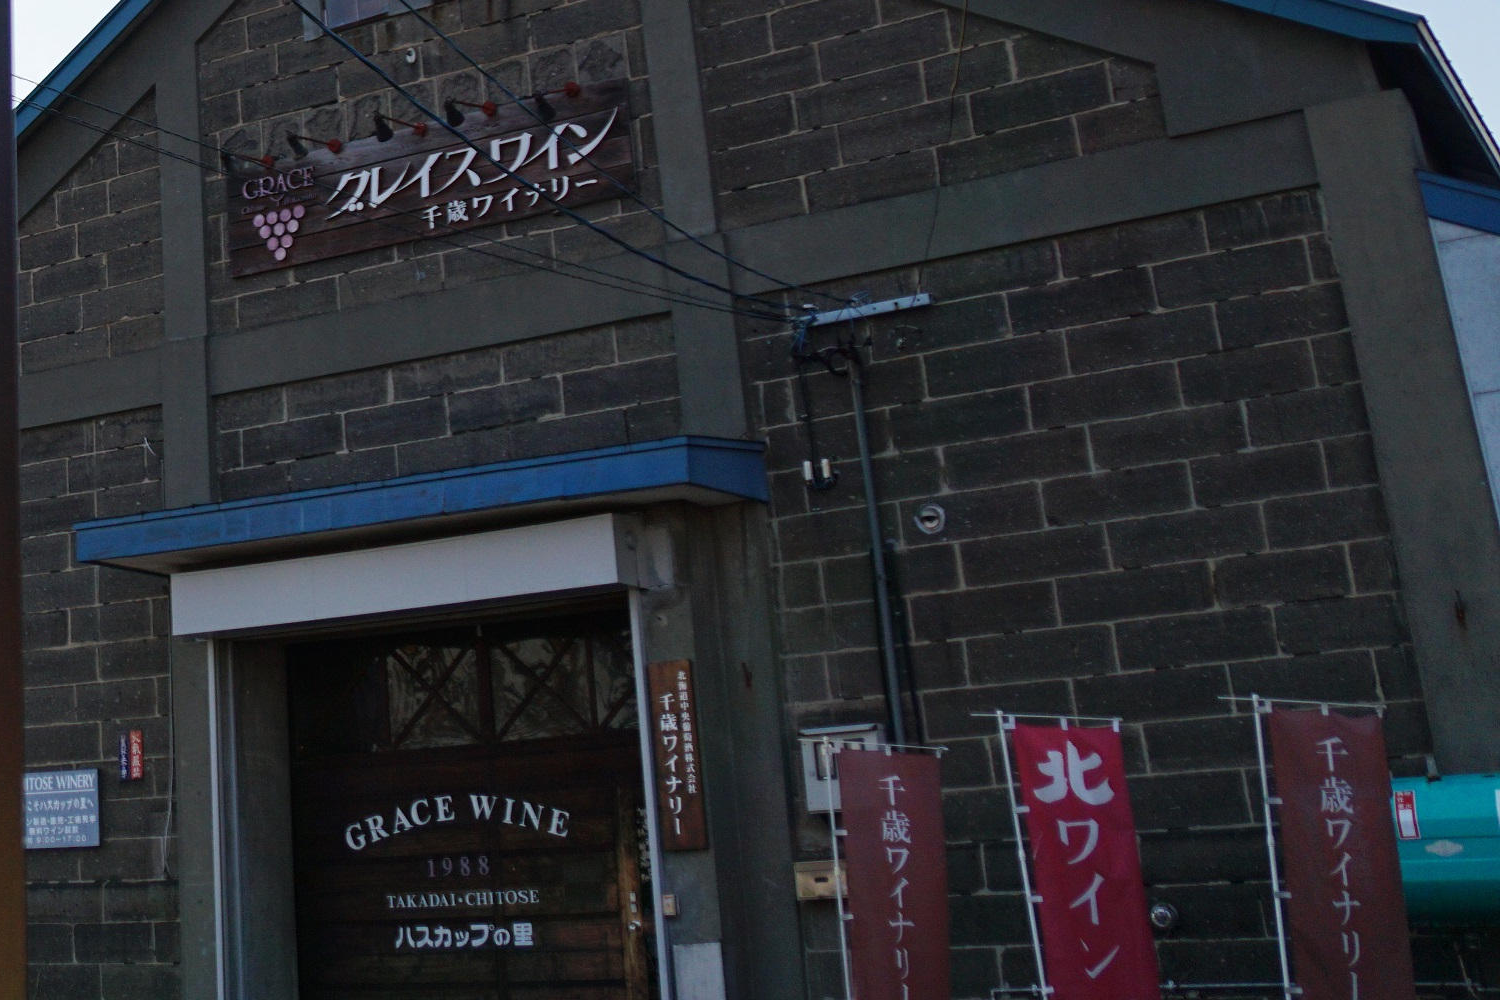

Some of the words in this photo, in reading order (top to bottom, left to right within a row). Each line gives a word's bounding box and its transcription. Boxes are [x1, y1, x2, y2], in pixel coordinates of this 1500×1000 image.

[242, 165, 316, 201] GRACE
[324, 105, 619, 221] グレイスワイン
[421, 176, 599, 230] 千歳ワイナリー
[55, 773, 94, 789] WINERY
[659, 692, 683, 835] 千歳ワイナリー
[345, 795, 455, 851] GRACE
[469, 794, 570, 838] WINE
[427, 855, 490, 878] 1988
[1033, 739, 1116, 980] 北ワイン
[1316, 736, 1361, 1000] 千歳ワイナリー
[396, 922, 534, 949] ハスカップの里
